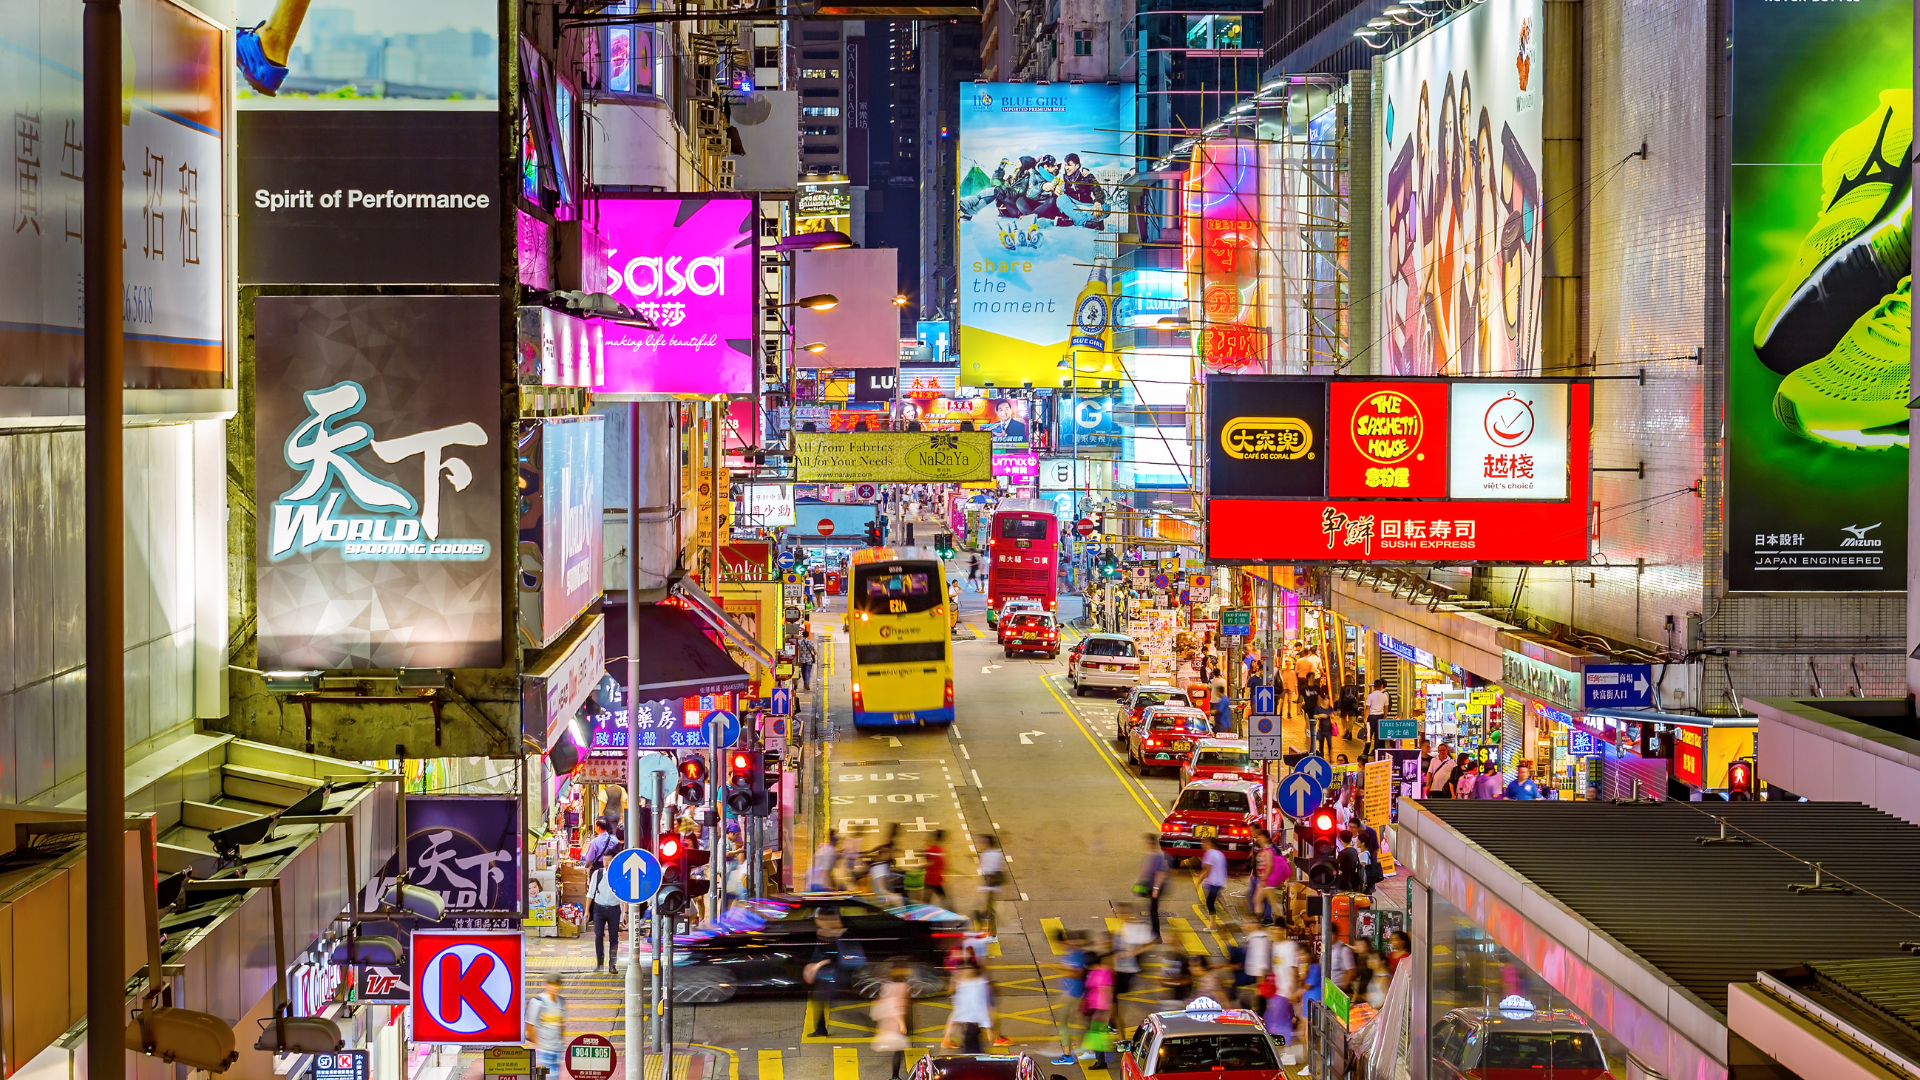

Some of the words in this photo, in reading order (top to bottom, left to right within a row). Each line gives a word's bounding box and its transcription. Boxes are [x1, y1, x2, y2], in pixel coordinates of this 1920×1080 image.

[847, 44, 855, 79] GALA
[847, 85, 855, 128] PLACE
[1001, 97, 1032, 106] BLUE
[1036, 97, 1065, 106] GIRL
[13, 101, 200, 267] 廣告招租
[254, 188, 314, 213] Spirit
[319, 188, 343, 210] of
[347, 188, 490, 210] Performance
[972, 257, 1033, 273] share
[973, 278, 1007, 293] the
[133, 285, 153, 324] 5618
[972, 298, 1056, 313] moment
[605, 335, 644, 351] making
[645, 333, 667, 352] life
[668, 333, 717, 352] beautiful
[1089, 340, 1103, 349] GIRL
[911, 376, 941, 389] 永成
[1371, 395, 1401, 414] THE
[796, 443, 812, 452] All
[816, 441, 845, 455] from
[849, 442, 893, 452] Fabrics
[1368, 437, 1409, 459] HOUSE
[283, 379, 490, 542] 天下
[796, 456, 811, 466] All
[813, 455, 830, 470] for
[830, 456, 857, 466] Your
[861, 455, 893, 466] Needs
[919, 451, 969, 467] NaRaYa
[1483, 453, 1534, 480] 越棧
[1365, 467, 1411, 488] 意粉屋
[273, 492, 421, 556] WORLD
[1380, 519, 1476, 540] 回転寿司
[1380, 540, 1418, 549] SUSHI
[1420, 540, 1476, 549] EXPRESS
[1755, 534, 1805, 546] 日本設計
[1840, 538, 1882, 547] MIZUNO
[345, 543, 426, 555] SPORTING
[429, 543, 485, 555] GOODS
[999, 555, 1022, 563] 周大福
[1756, 557, 1797, 565] JAPAN
[1802, 557, 1881, 565] ENGINEERED
[1619, 674, 1633, 683] 商場
[1593, 689, 1628, 700] 快富街入口
[595, 706, 677, 729] 中西藥房
[595, 731, 657, 746] 政府册
[1387, 728, 1410, 736] 的士站
[838, 772, 921, 782] BUS
[830, 793, 939, 804] STOP
[416, 830, 512, 908] 天下
[365, 975, 402, 995] 1/F
[575, 1049, 589, 1057] 904
[594, 1049, 608, 1057] 905
